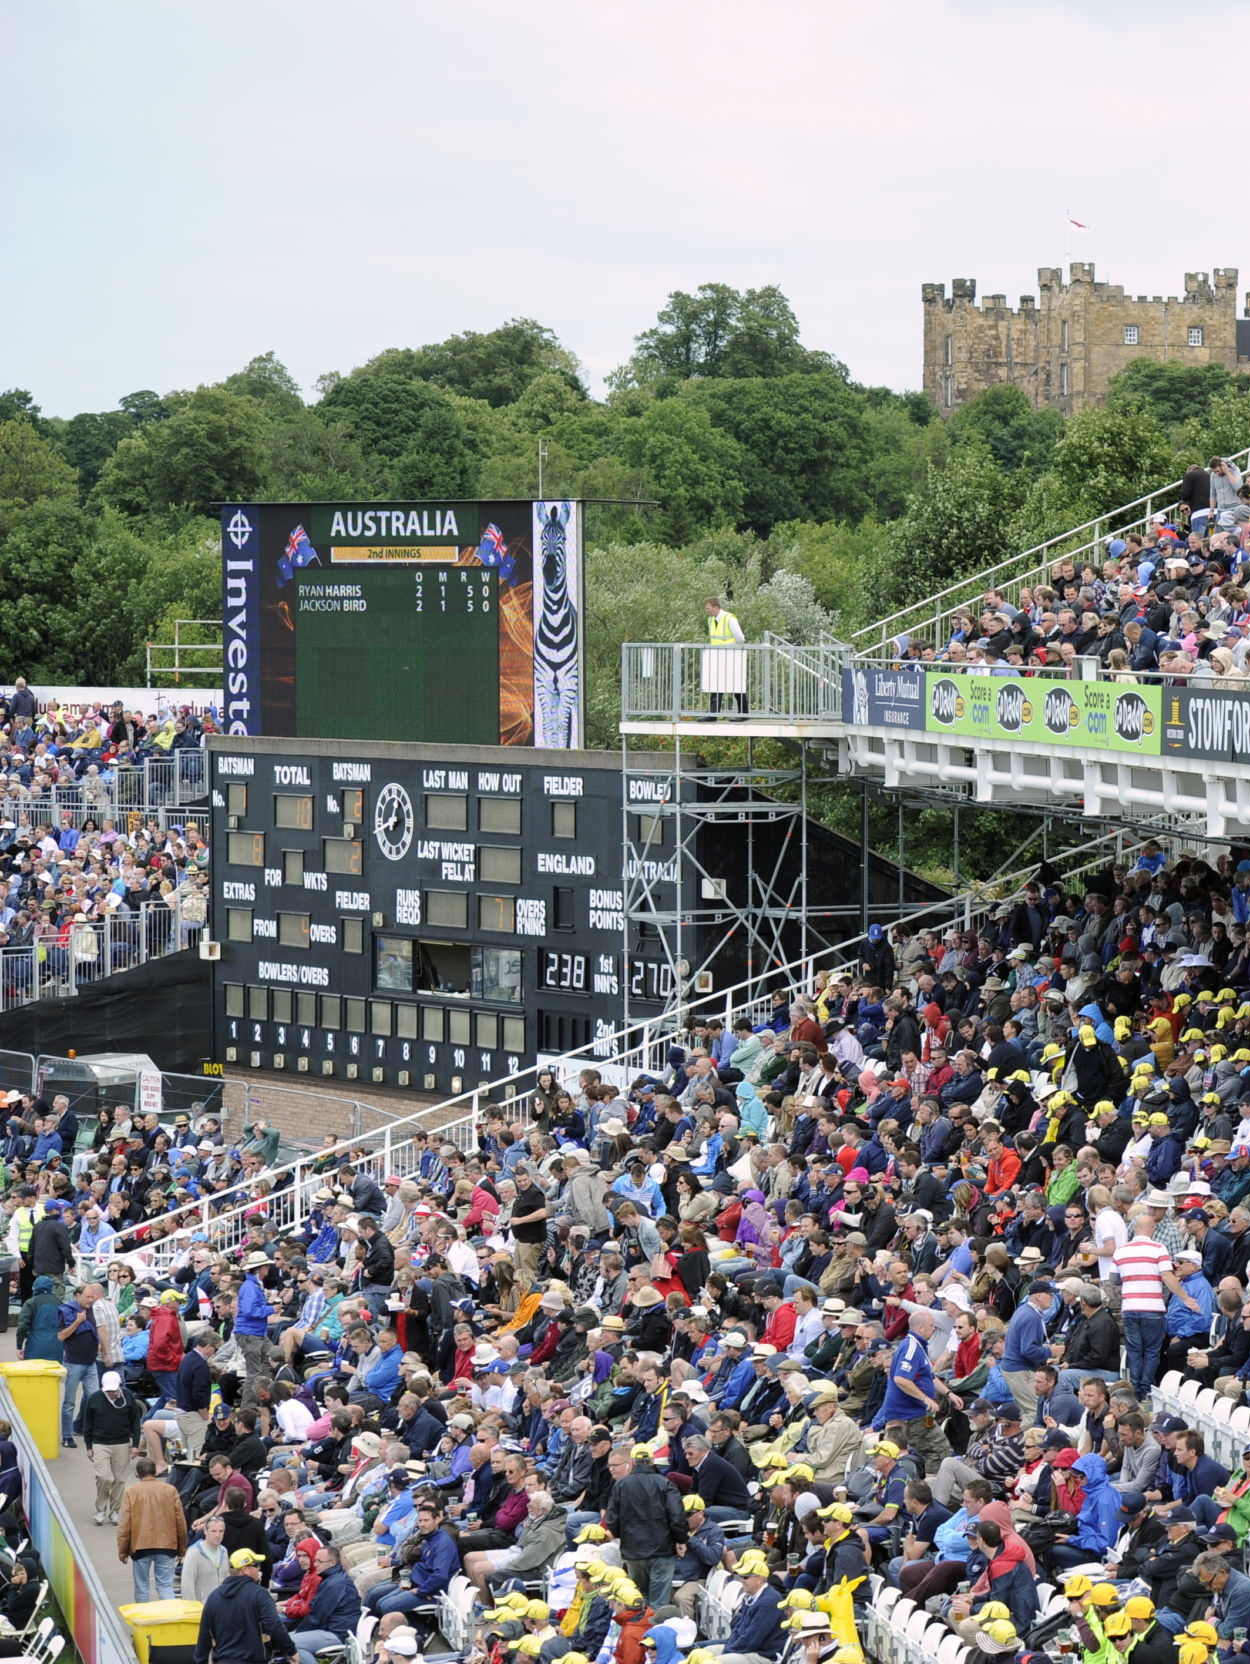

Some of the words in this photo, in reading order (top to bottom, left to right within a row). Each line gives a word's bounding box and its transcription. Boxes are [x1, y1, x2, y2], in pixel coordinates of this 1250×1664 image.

[330, 510, 459, 537] AUSTRALIA
[367, 548, 384, 559] 2nd
[385, 548, 421, 559] INNINGS
[415, 571, 423, 582] O
[438, 571, 447, 582] M
[460, 571, 467, 582] R
[481, 571, 490, 582] W
[298, 585, 323, 597] RYAN
[325, 584, 361, 597] HARRIS
[415, 585, 422, 597] 2
[440, 585, 446, 597] 1
[467, 585, 473, 597] 5
[482, 585, 490, 597] 0
[298, 599, 340, 612] JACKSON
[343, 599, 367, 612] BIRD
[415, 600, 422, 612] 2
[440, 600, 446, 612] 1
[467, 600, 473, 612] 5
[482, 600, 490, 612] 0
[874, 673, 896, 706] Liberty
[896, 676, 920, 699] Mutual
[970, 680, 987, 701] Score
[987, 687, 992, 702] a
[1084, 684, 1105, 709] Score
[1105, 692, 1110, 709] a
[884, 710, 910, 725] INSURANCE
[218, 757, 255, 776] BATSMAN
[274, 766, 311, 785] TOTAL
[333, 763, 371, 782] BATSMAN
[423, 770, 446, 788] LAST
[448, 771, 469, 790] MAN
[478, 773, 500, 791] HOW
[502, 774, 522, 792] OUT
[544, 776, 584, 796] FIELDER
[212, 789, 225, 807] No.
[629, 780, 671, 801] BOWLED
[326, 794, 340, 813] No.
[353, 790, 363, 818] 2
[417, 840, 440, 859] LAST
[441, 842, 476, 862] WICKET
[442, 862, 463, 881] FELL
[464, 863, 476, 882] AT
[537, 853, 596, 876] ENGLAND
[264, 868, 282, 887] FOR
[303, 872, 328, 891] WKTS
[223, 881, 256, 901] EXTRAS
[335, 890, 370, 911] FIELDER
[396, 889, 420, 908] RUNS
[589, 889, 623, 910] BONUS
[516, 898, 546, 918] OVERS
[253, 919, 277, 938] FROM
[516, 915, 546, 936] R'NING
[589, 911, 624, 931] POINTS
[310, 924, 337, 944] OVERS
[546, 953, 586, 987] 238
[599, 953, 614, 973] 1st
[258, 961, 330, 987] BOWLERS/OVERS
[594, 973, 619, 995] INN'S
[632, 961, 672, 996] 270
[596, 1018, 616, 1037] 2nd
[231, 1021, 237, 1039] 1
[254, 1023, 262, 1042] 2
[278, 1026, 286, 1045] 3
[302, 1029, 311, 1048] 4
[327, 1033, 335, 1051] 5
[351, 1036, 360, 1055] 6
[376, 1039, 386, 1058] 7
[402, 1042, 410, 1061] 8
[428, 1045, 437, 1064] 9
[453, 1049, 465, 1069] 10
[481, 1053, 492, 1072] 11
[507, 1056, 520, 1074] 12
[593, 1036, 619, 1058] INN'S
